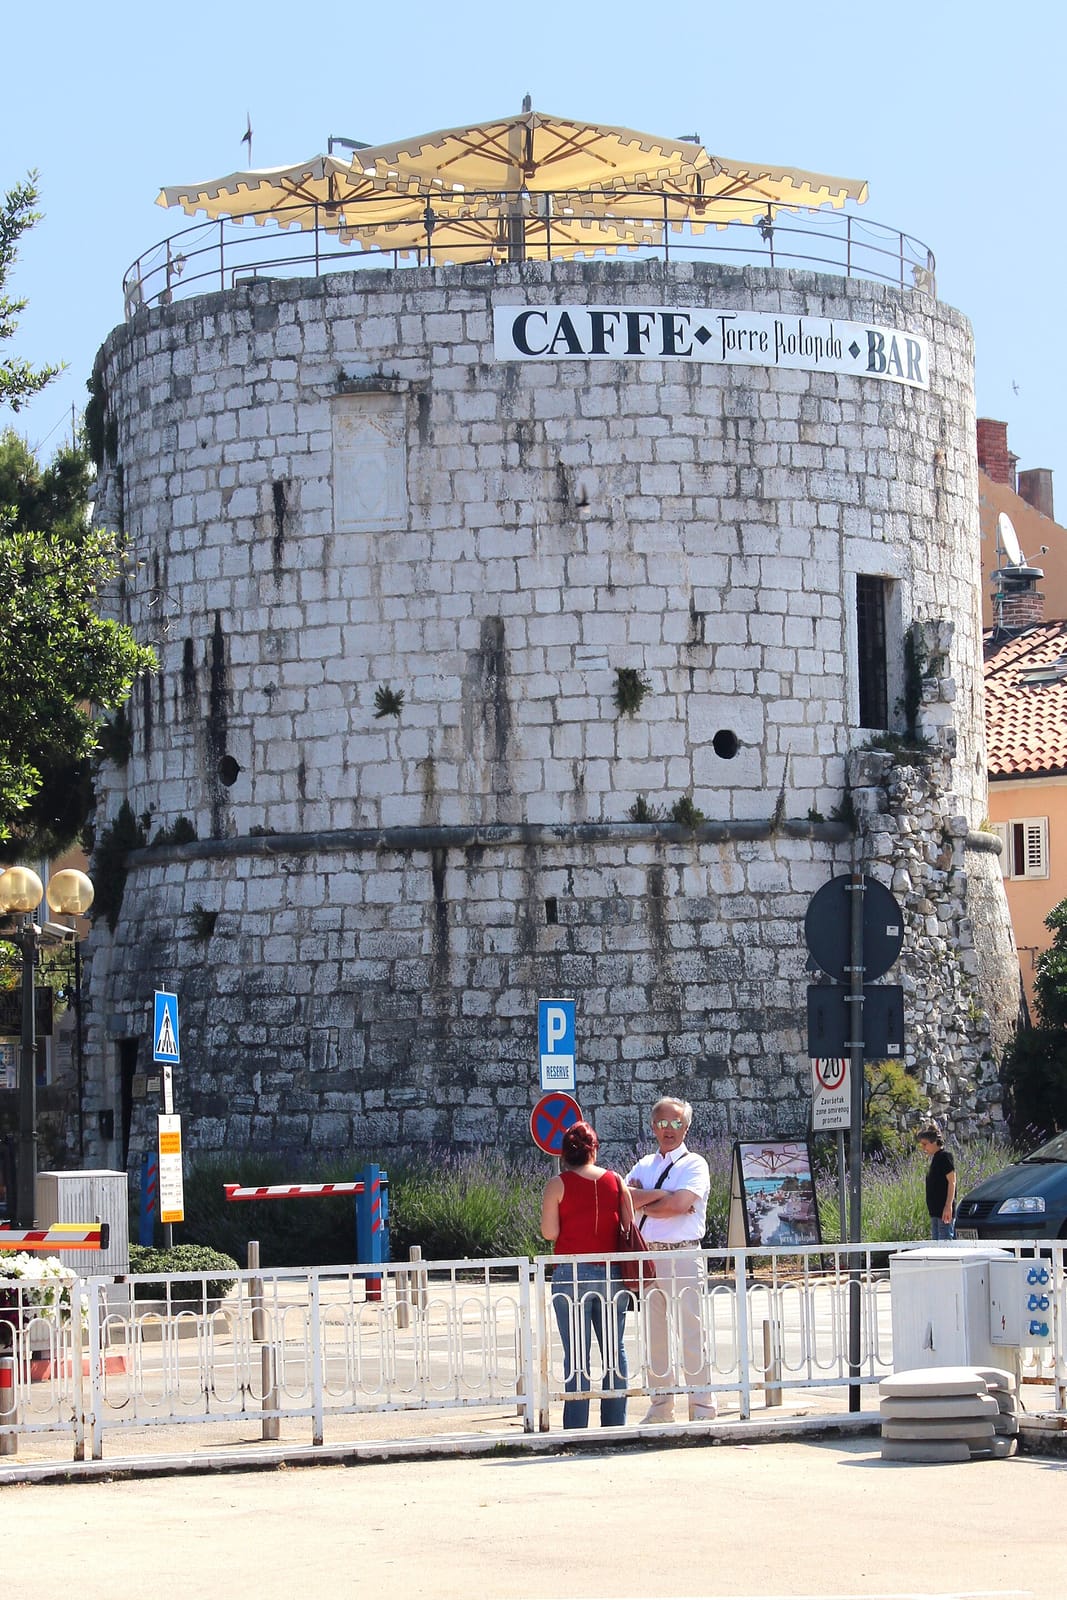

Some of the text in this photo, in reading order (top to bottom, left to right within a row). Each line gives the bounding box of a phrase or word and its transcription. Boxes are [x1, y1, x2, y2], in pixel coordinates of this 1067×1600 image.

[512, 311, 693, 356] CAFFE
[716, 312, 768, 361] Torre
[865, 330, 924, 383] BAR
[547, 1007, 567, 1052] P
[821, 1058, 840, 1079] 20
